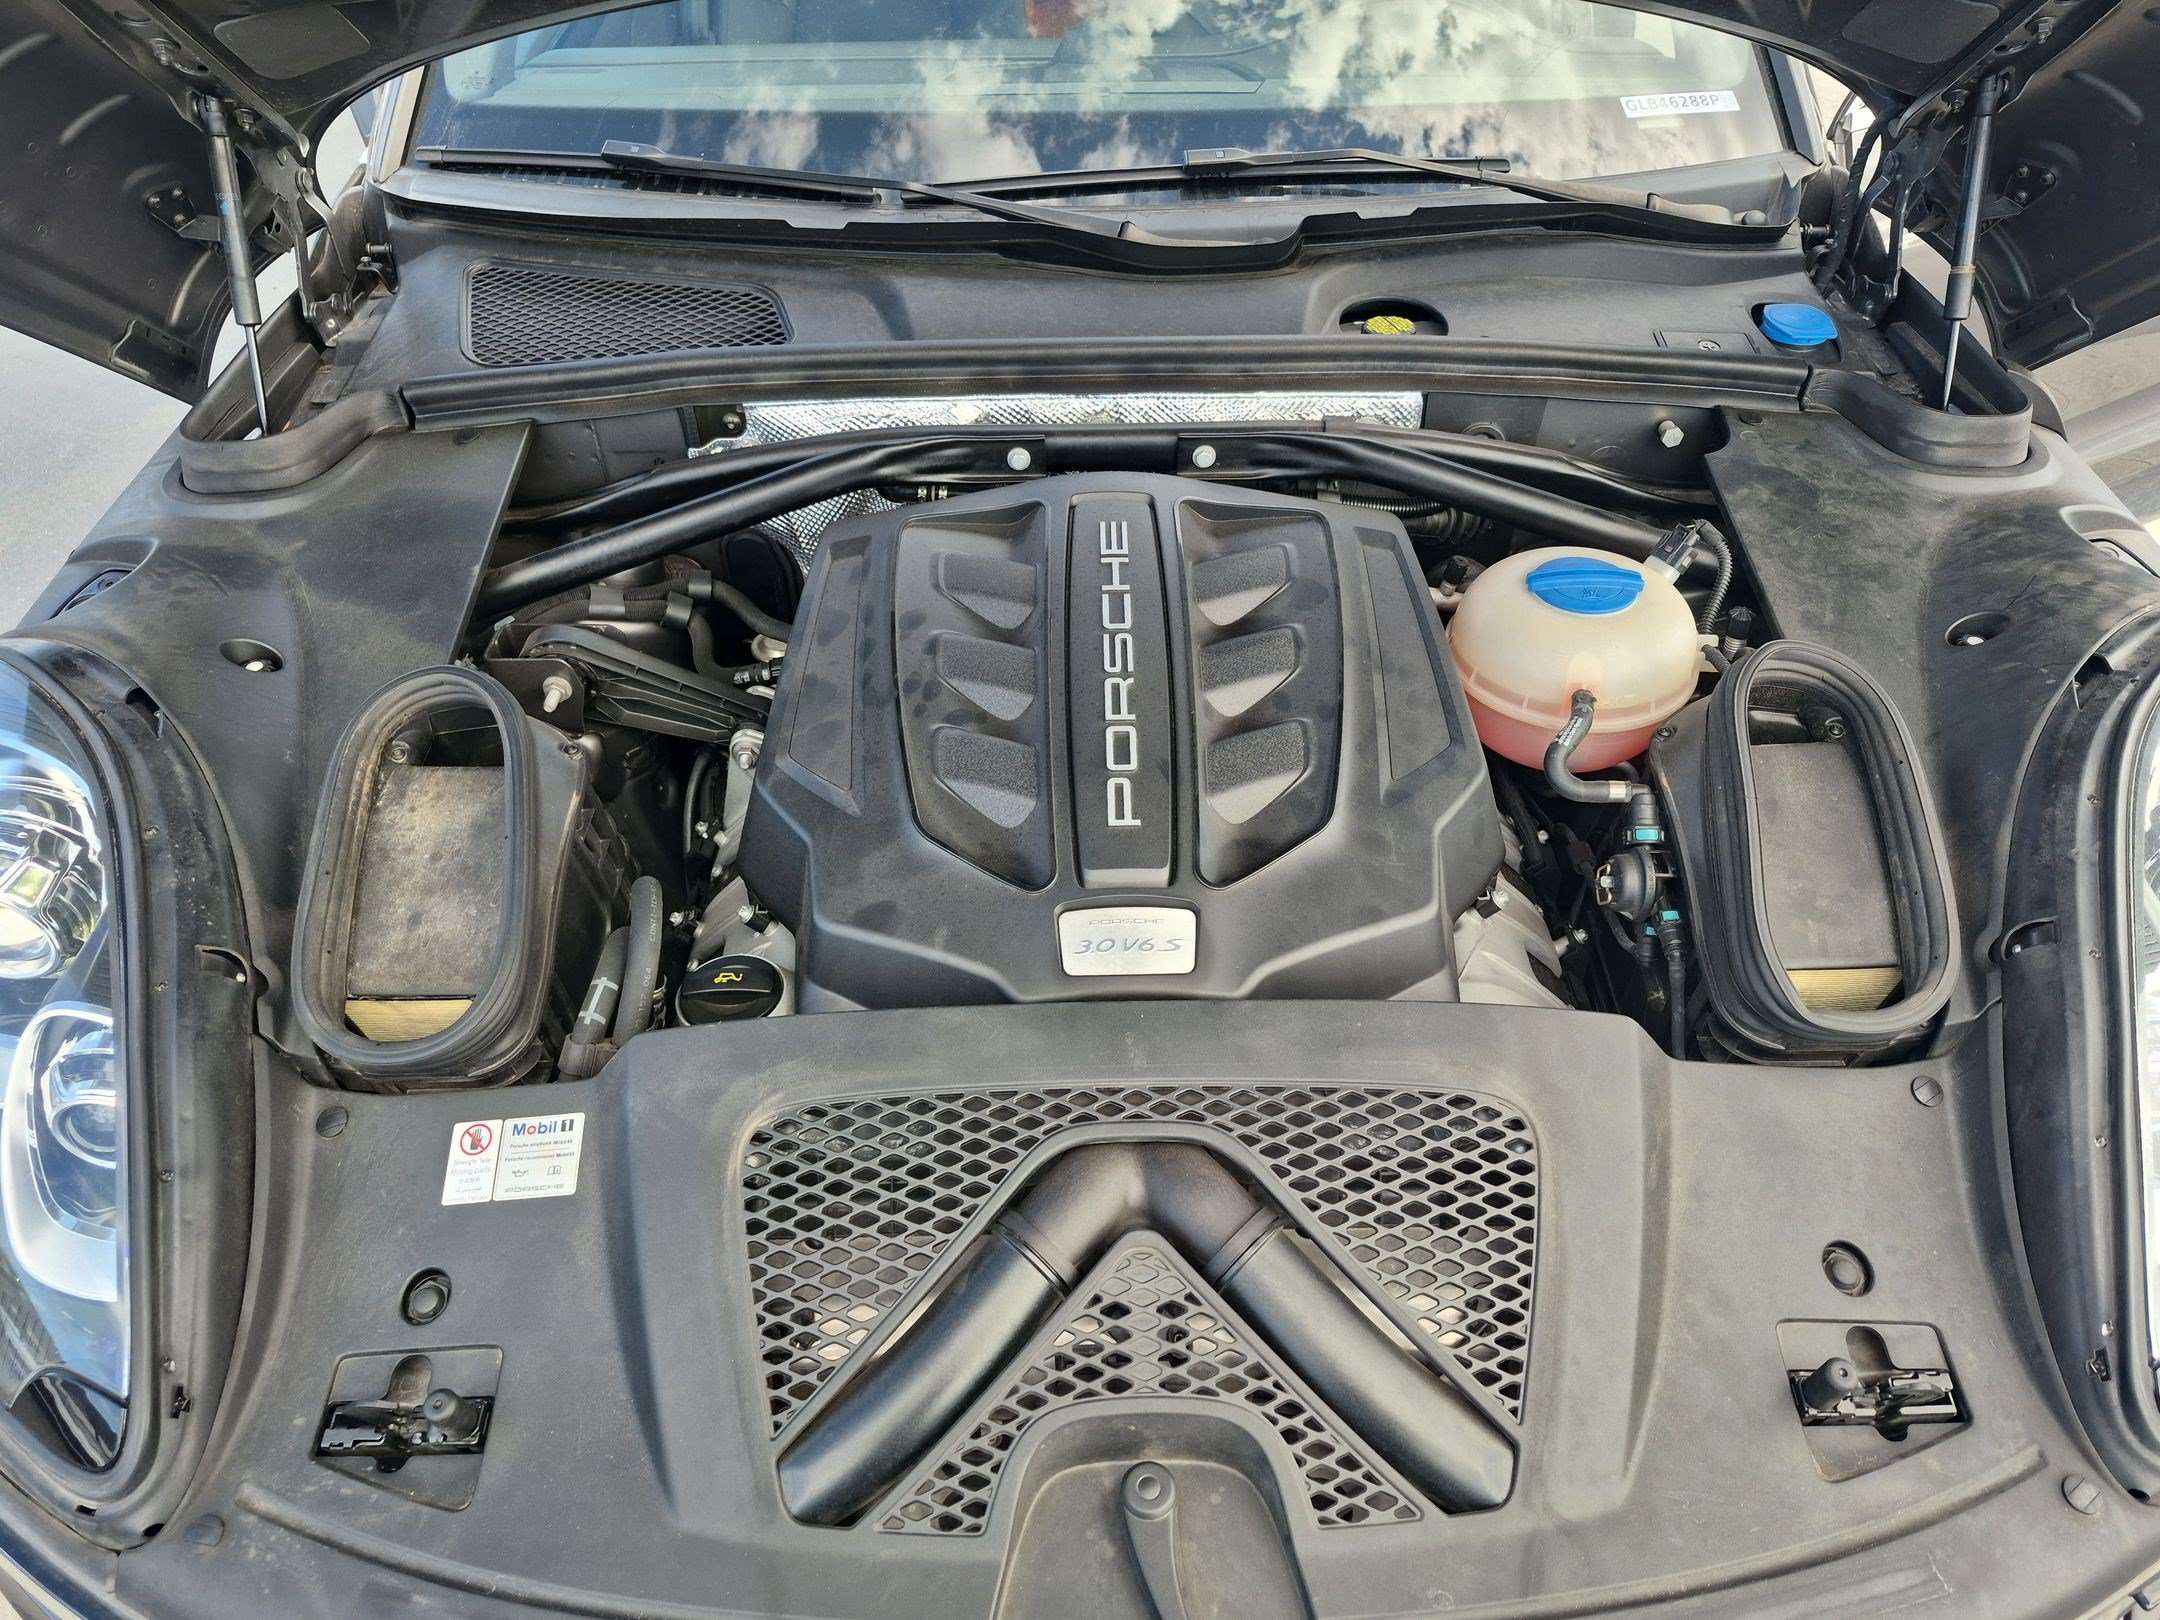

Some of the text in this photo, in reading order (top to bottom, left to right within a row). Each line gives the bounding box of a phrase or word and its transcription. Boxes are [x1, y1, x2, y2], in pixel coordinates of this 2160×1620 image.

[1624, 94, 1720, 112] GLB46288P
[1100, 521, 1141, 827] PORSCHE
[1089, 918, 1165, 926] PORSCHE
[1074, 939, 1115, 954] 3.0
[1157, 938, 1184, 952] S
[512, 1121, 558, 1136] Mobil
[505, 1183, 565, 1193] PORSCHE
